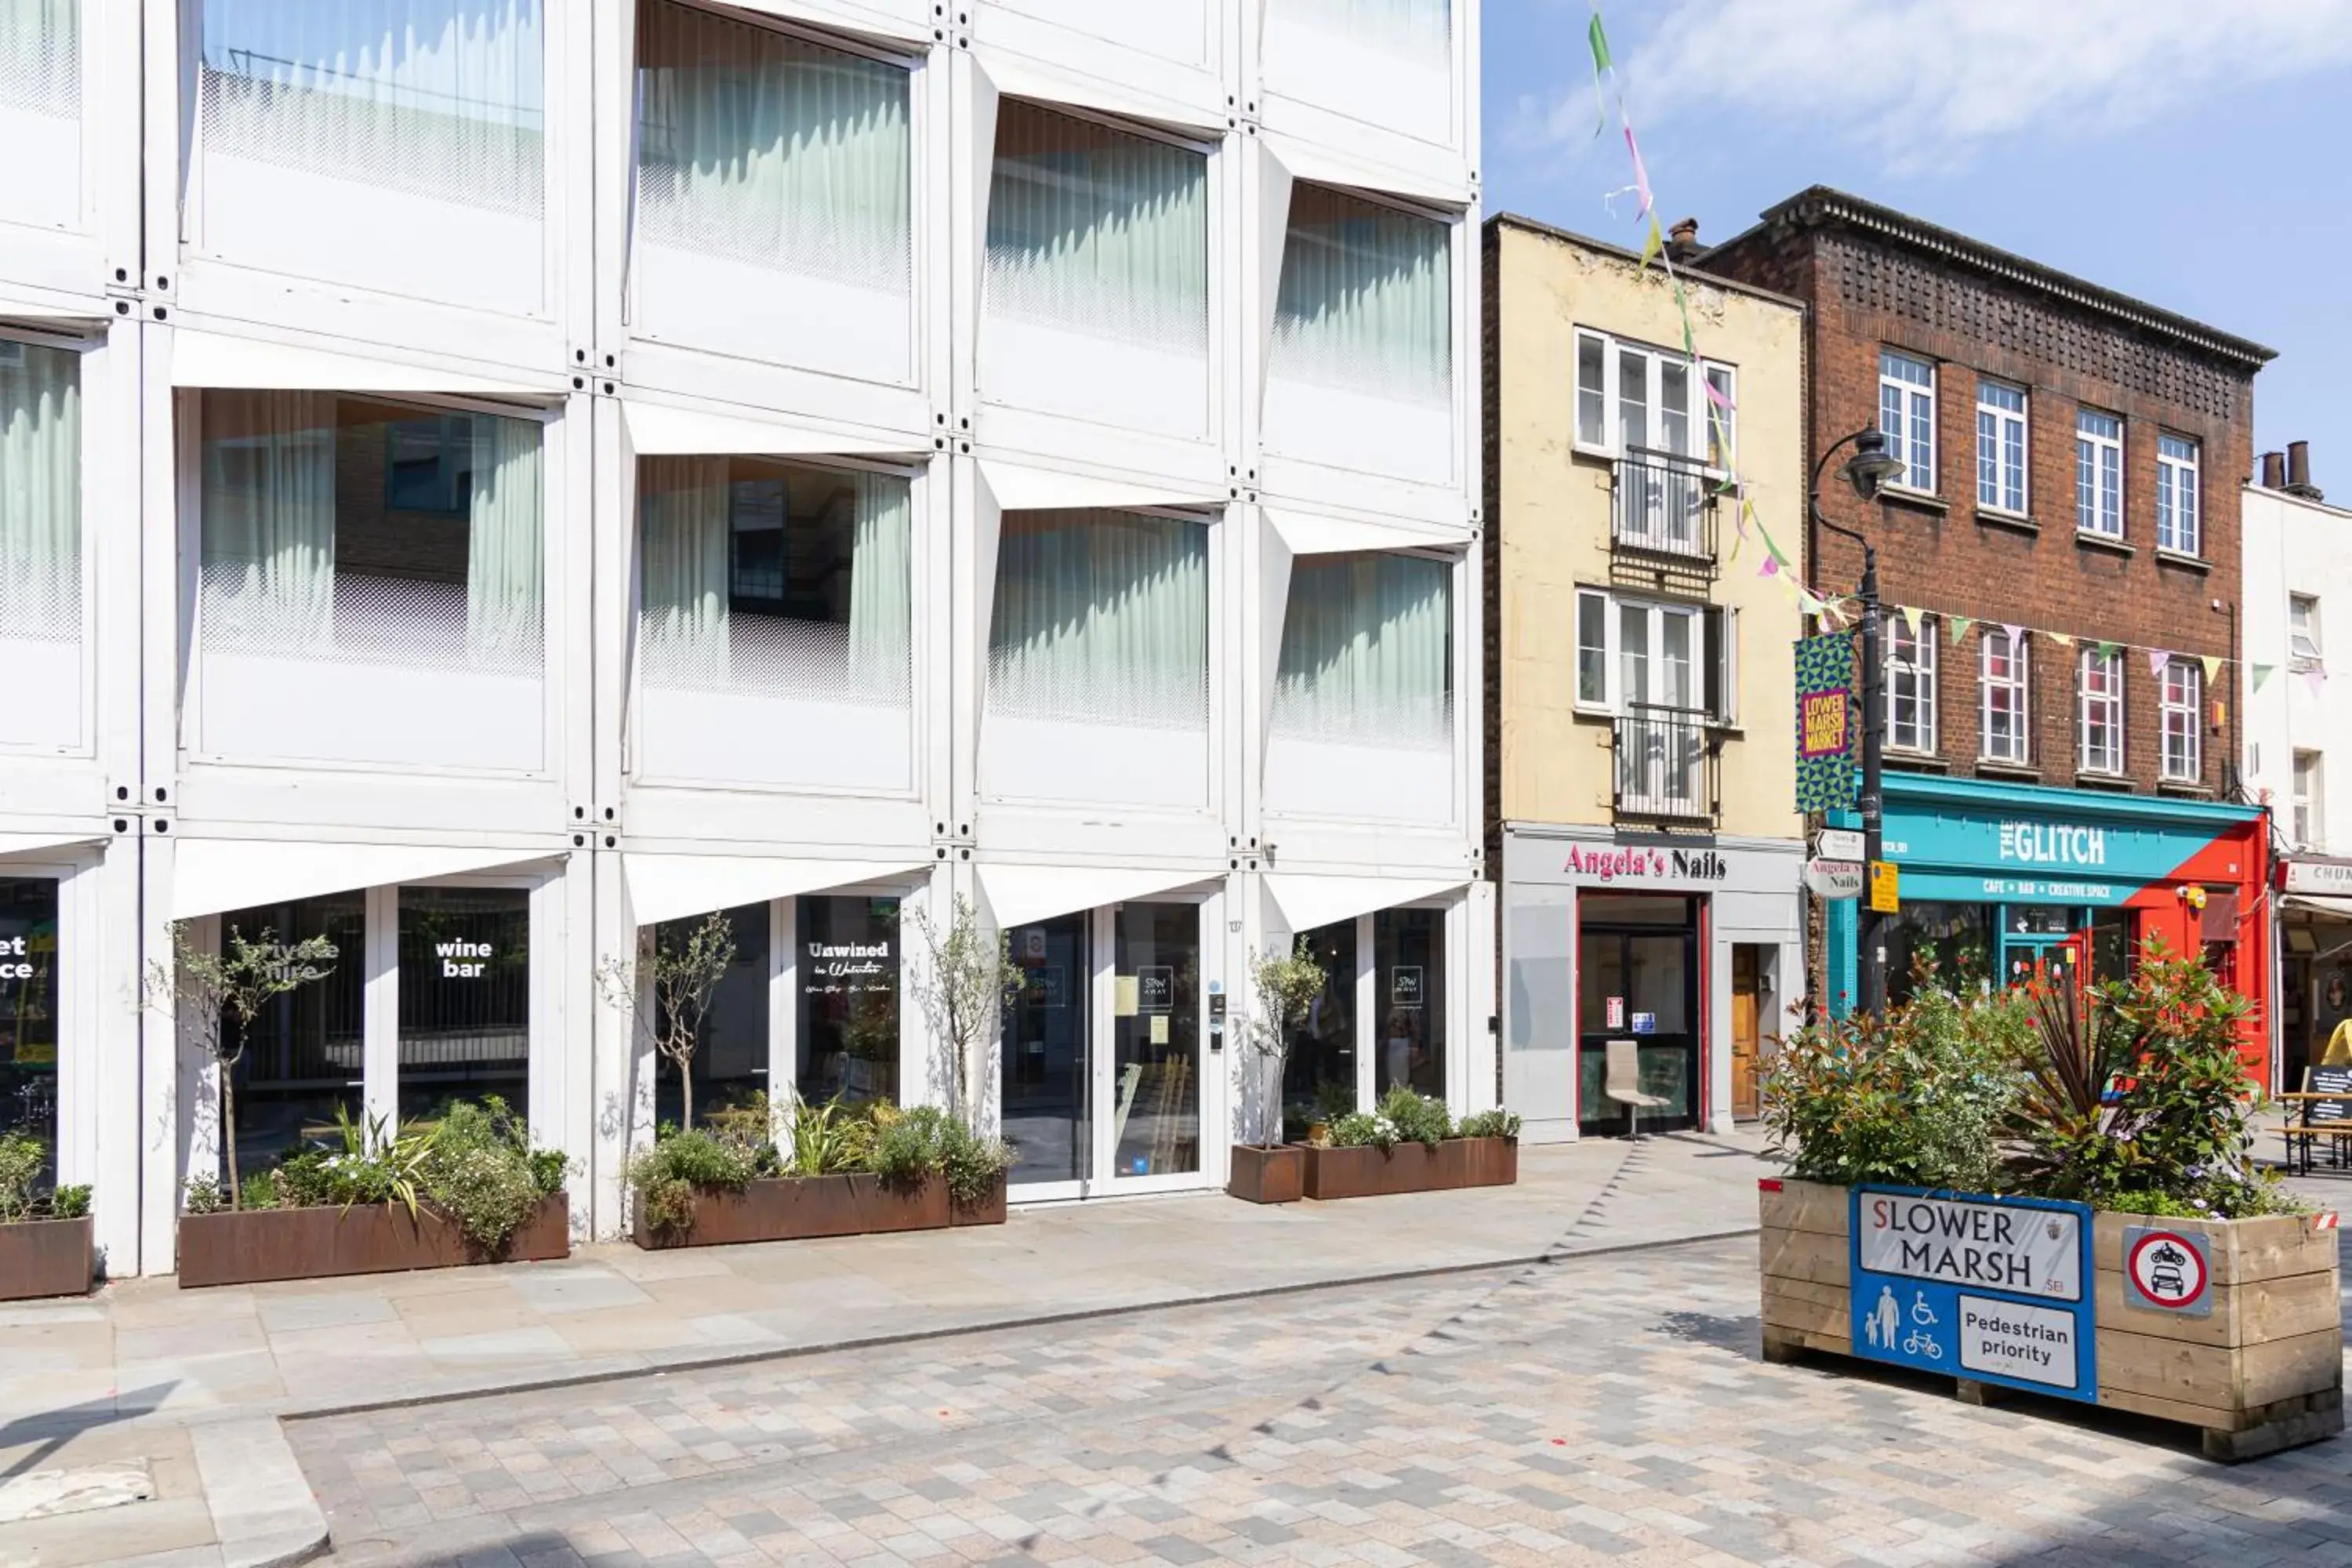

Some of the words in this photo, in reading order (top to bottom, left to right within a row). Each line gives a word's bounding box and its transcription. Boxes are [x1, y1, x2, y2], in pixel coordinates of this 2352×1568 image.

[1806, 694, 1844, 716] LOWER
[1806, 711, 1844, 732] MARSH
[1806, 730, 1843, 753] MARKET
[2001, 819, 2014, 860] THE
[2014, 822, 2105, 865] GLITCH
[1564, 842, 1666, 882] Angela's
[1671, 849, 1727, 880] Nails
[1813, 862, 1860, 875] Angelas
[1830, 876, 1859, 888] Nails
[1983, 879, 2005, 894] CAFE
[2018, 882, 2035, 895] BAR
[2049, 883, 2085, 897] CREATIVE
[2086, 885, 2111, 898] SPACE
[435, 937, 492, 957] wine
[808, 942, 889, 957] Unwined
[443, 959, 485, 978] bar
[1873, 1199, 2014, 1246] SLOWER
[1901, 1240, 2031, 1287] MARSH
[1965, 1312, 2068, 1345] Pedestrian
[1982, 1340, 2052, 1367] priority
